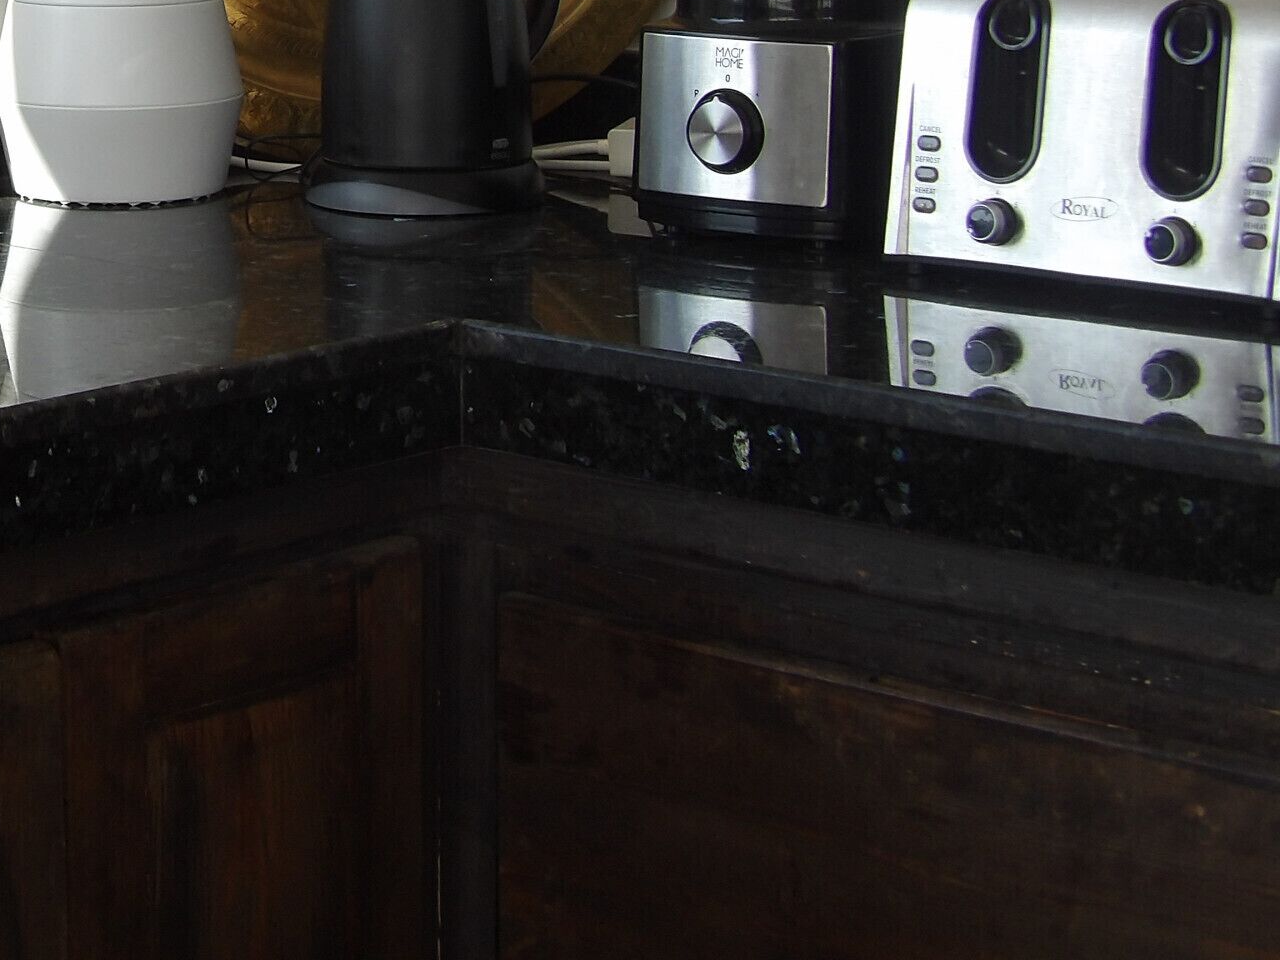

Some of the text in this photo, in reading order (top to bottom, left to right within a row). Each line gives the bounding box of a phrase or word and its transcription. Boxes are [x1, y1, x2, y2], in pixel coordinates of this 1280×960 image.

[716, 57, 743, 69] HOME
[694, 89, 699, 97] P
[919, 124, 942, 133] CANCEL
[915, 155, 941, 163] DEFROST
[914, 186, 935, 194] REHEAT
[1243, 188, 1271, 197] DEFROST
